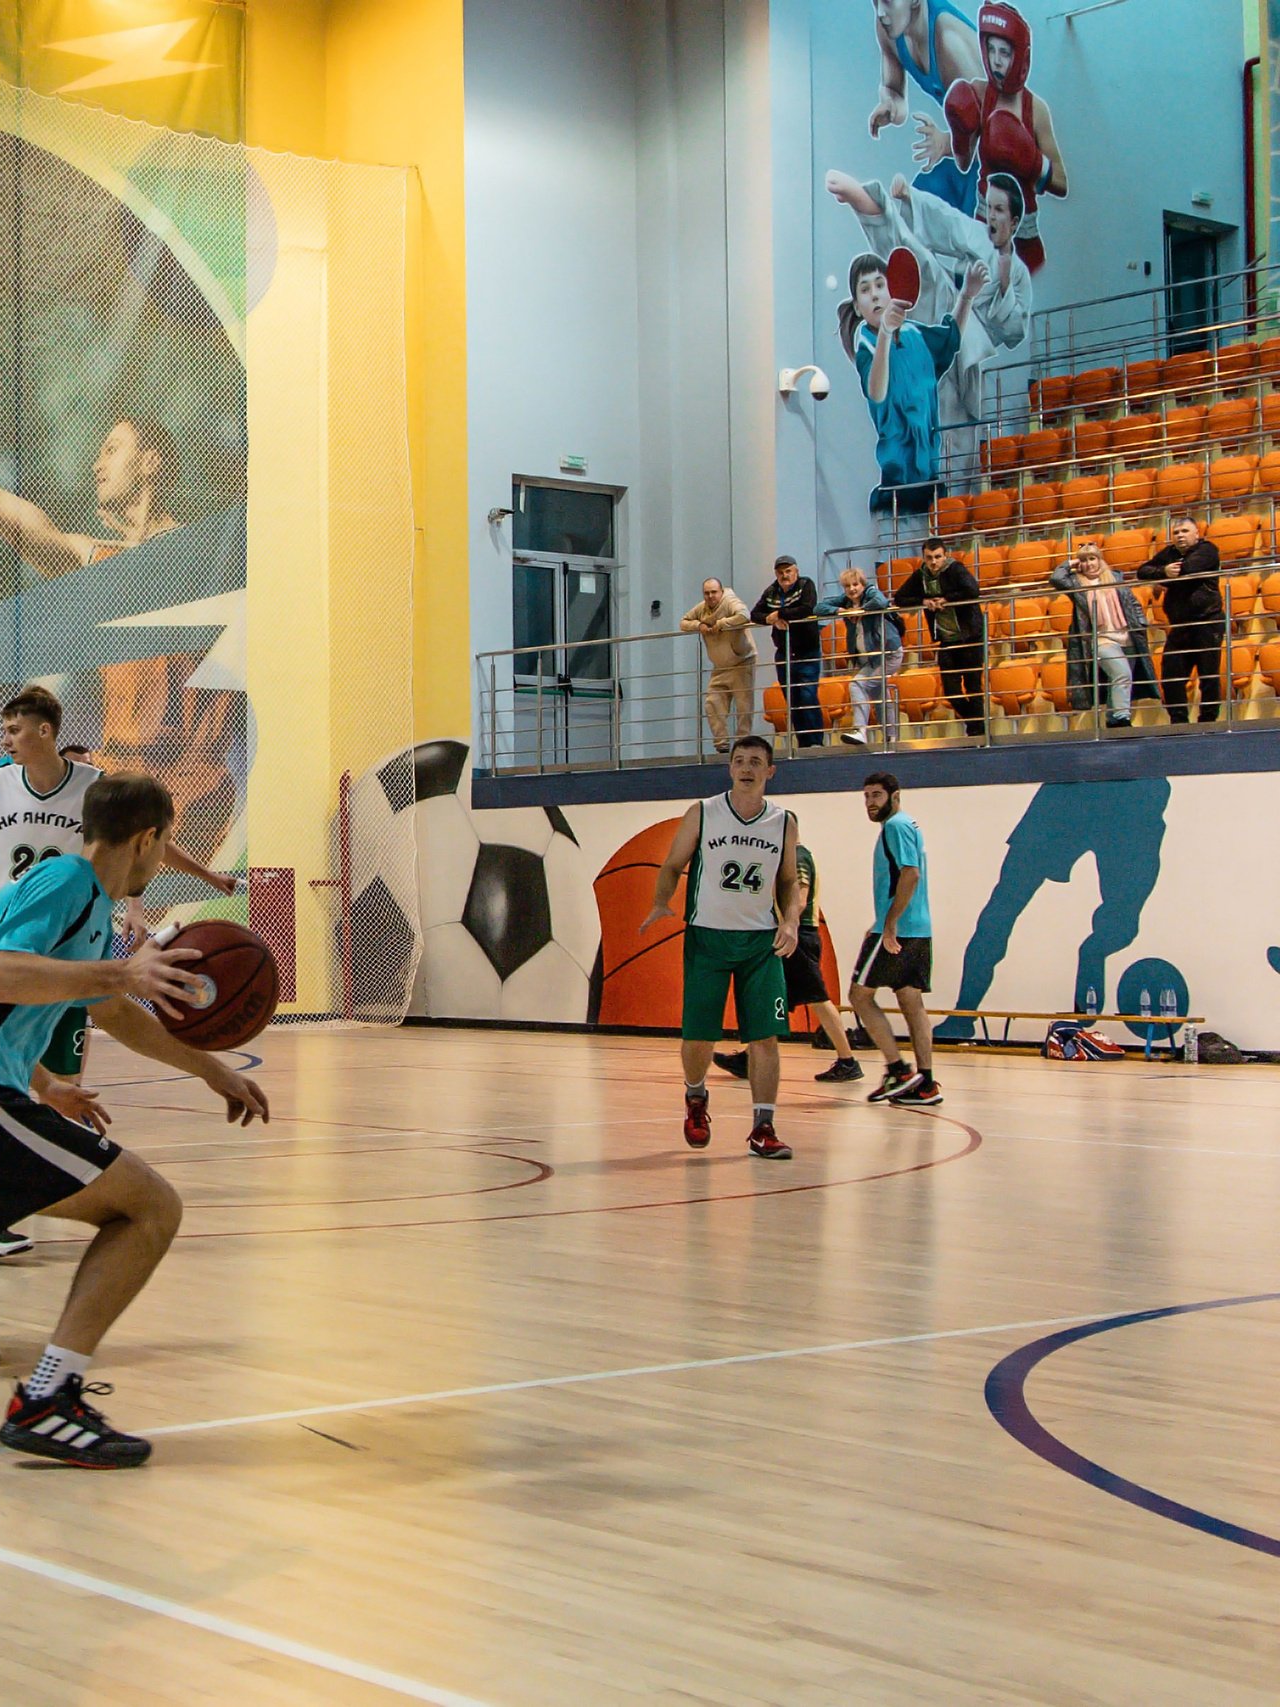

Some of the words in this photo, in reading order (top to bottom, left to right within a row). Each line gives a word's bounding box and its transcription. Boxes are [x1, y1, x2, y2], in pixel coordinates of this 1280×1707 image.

[708, 835, 727, 850] НК
[731, 835, 779, 854] ЯНГПУР
[720, 860, 764, 894] 24
